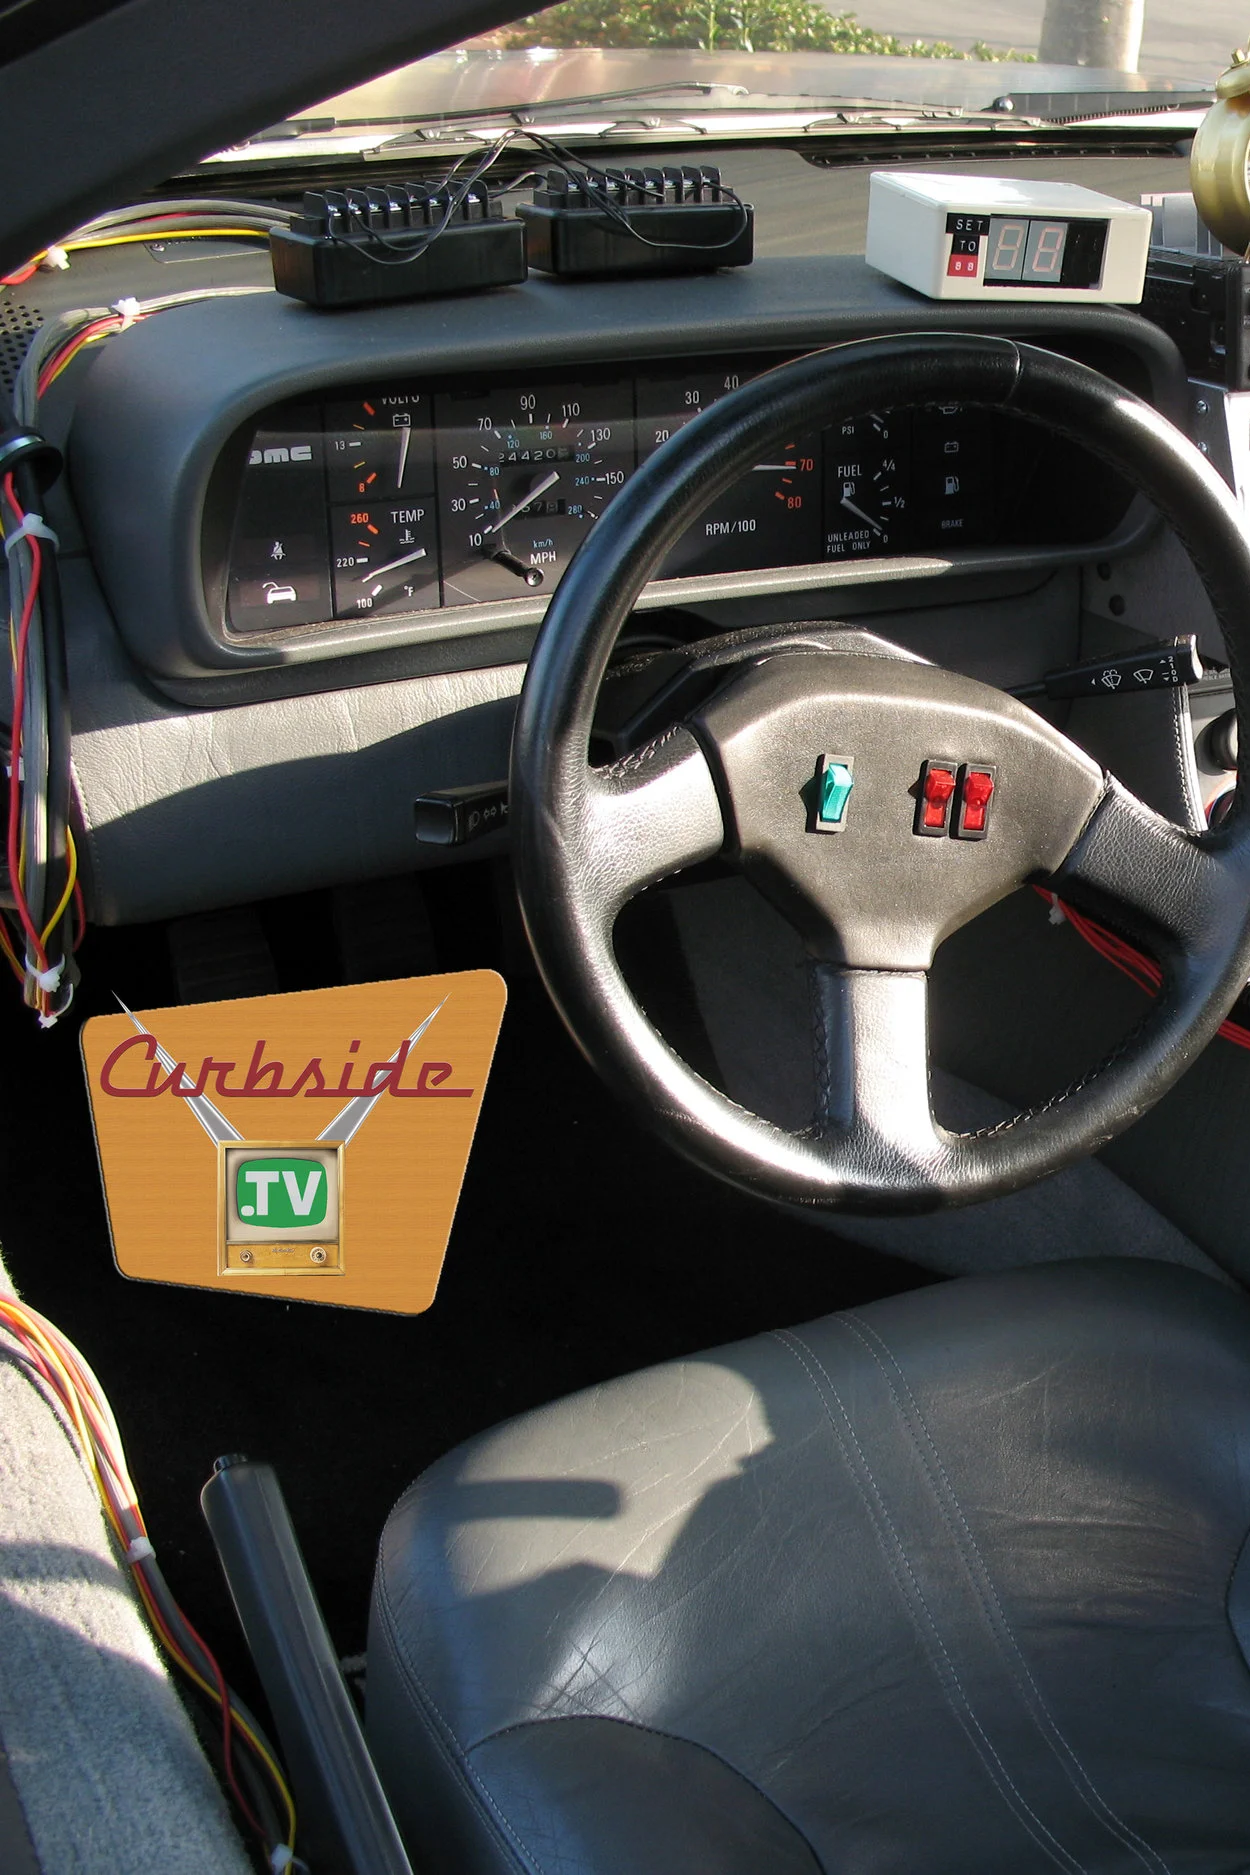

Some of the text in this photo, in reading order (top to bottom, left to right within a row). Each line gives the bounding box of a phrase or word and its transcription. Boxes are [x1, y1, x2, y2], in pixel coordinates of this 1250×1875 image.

[956, 219, 983, 231] SET
[960, 240, 976, 252] TO
[724, 376, 739, 390] 40
[520, 395, 536, 411] 90
[685, 391, 700, 405] 30
[562, 403, 580, 417] 110
[478, 417, 492, 431] 70
[591, 428, 611, 442] 130
[841, 426, 854, 435] PSI
[883, 430, 889, 439] 0
[655, 430, 669, 444] 20
[335, 440, 346, 450] 13
[507, 439, 520, 449] 120
[452, 456, 467, 469] 50
[575, 453, 590, 463] 200
[800, 458, 814, 471] 70
[882, 459, 896, 471] 4/4
[490, 467, 499, 476] 80
[837, 465, 862, 478] FUEL
[575, 476, 590, 486] 240
[605, 471, 624, 485] 150
[358, 483, 365, 493] 8
[452, 499, 466, 512] 30
[490, 501, 500, 509] 40
[787, 496, 802, 509] 80
[894, 496, 905, 509] 1/2
[568, 505, 583, 515] 280
[351, 513, 369, 524] 260
[391, 510, 425, 524] TEMP
[705, 519, 756, 536] RPM/100
[941, 519, 964, 529] BRAKE
[469, 533, 482, 547] 10
[827, 530, 870, 543] UNLEADED
[883, 535, 889, 543] 0
[533, 538, 553, 549] km/h
[827, 541, 871, 553] FUEL ONLY
[336, 556, 355, 567] 220
[530, 551, 556, 565] MPH
[356, 598, 373, 609] 100
